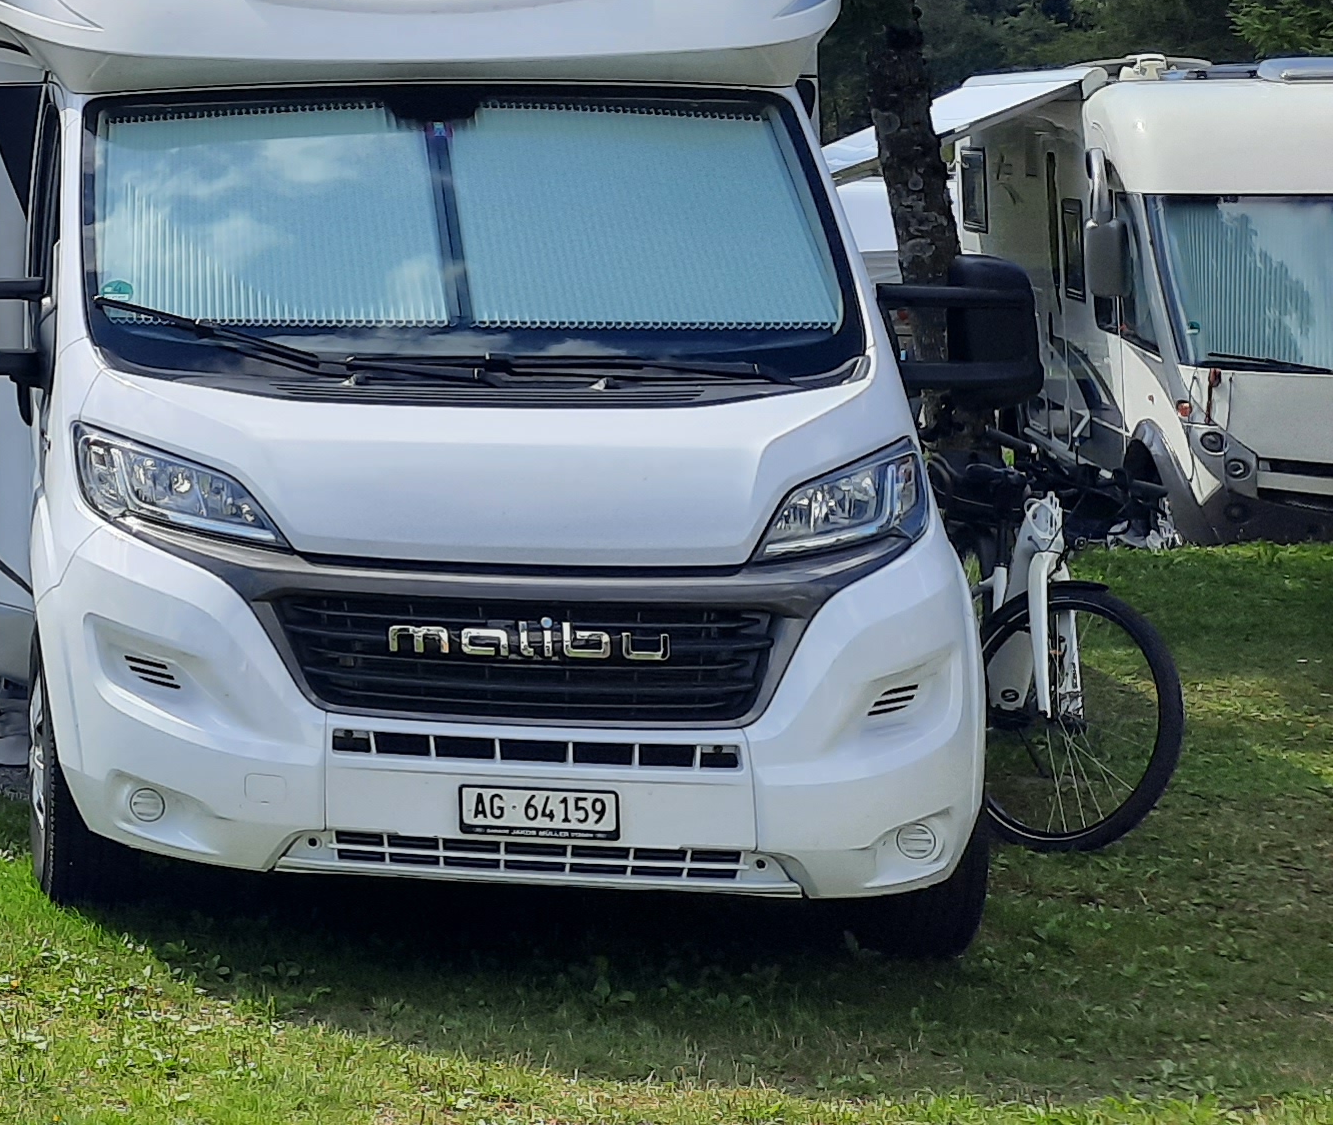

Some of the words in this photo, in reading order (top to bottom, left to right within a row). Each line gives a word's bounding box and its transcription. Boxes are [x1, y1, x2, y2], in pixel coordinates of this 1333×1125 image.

[388, 616, 671, 661] malibu
[473, 792, 505, 820] AG
[524, 794, 607, 825] 64159
